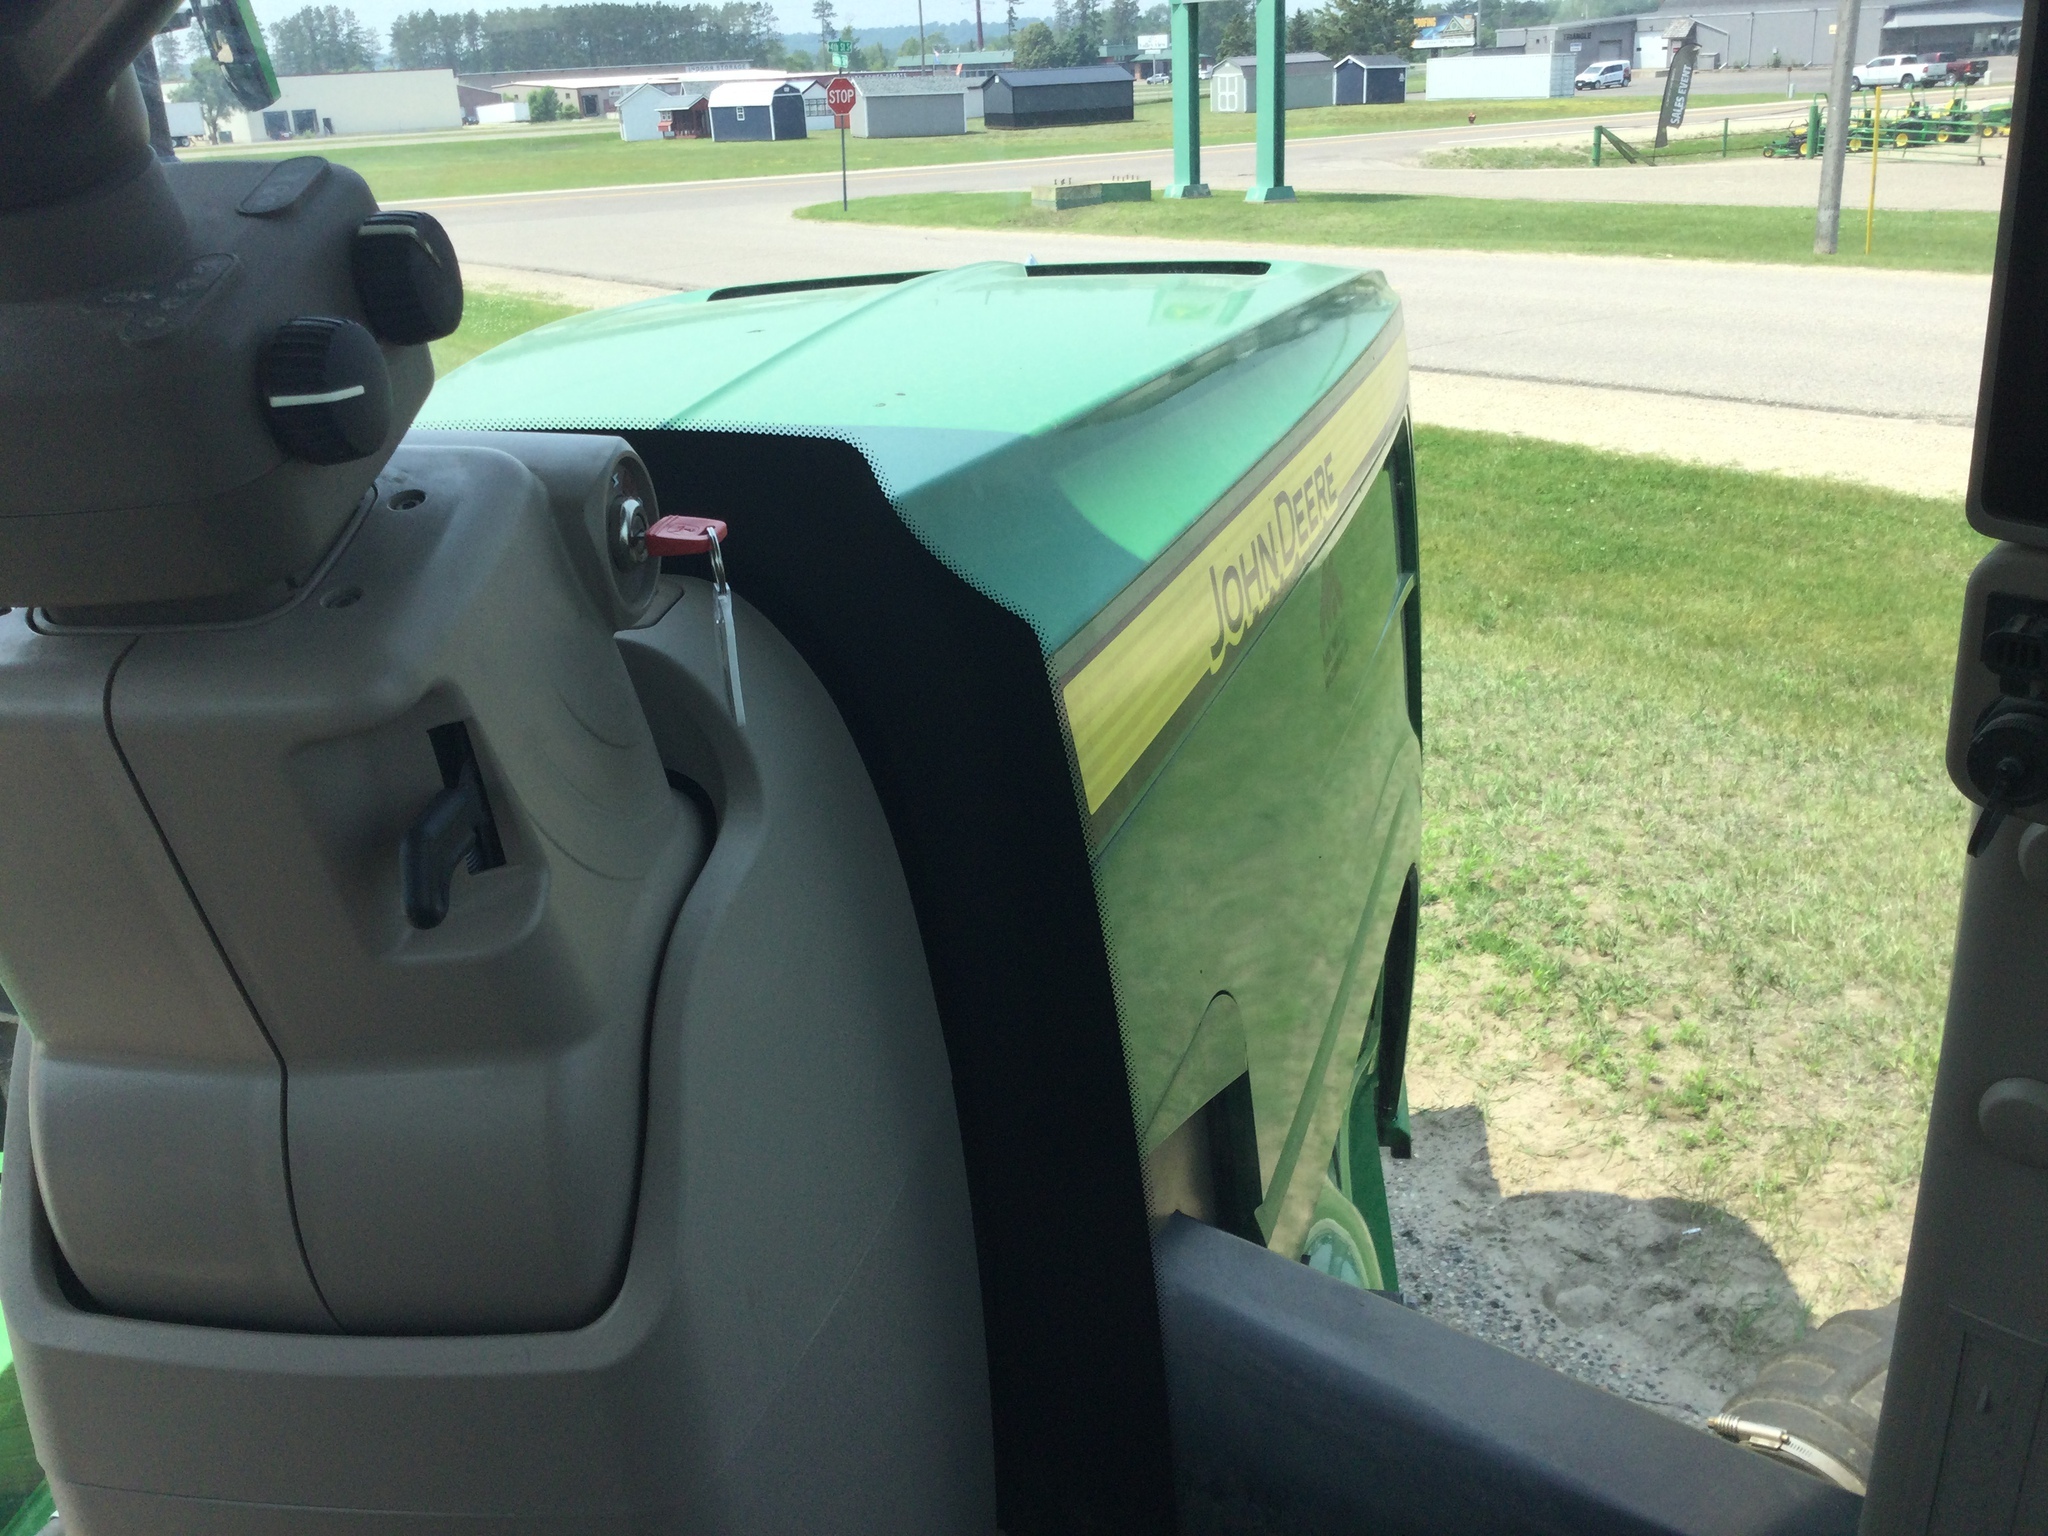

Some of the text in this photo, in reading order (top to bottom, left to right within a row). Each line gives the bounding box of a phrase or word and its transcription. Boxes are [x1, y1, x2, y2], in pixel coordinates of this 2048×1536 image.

[716, 63, 746, 71] STORAGE
[1677, 64, 1692, 95] EVENT
[828, 89, 854, 104] STOP
[1670, 96, 1685, 124] SALES
[1209, 451, 1338, 662] JOHN DEERE
